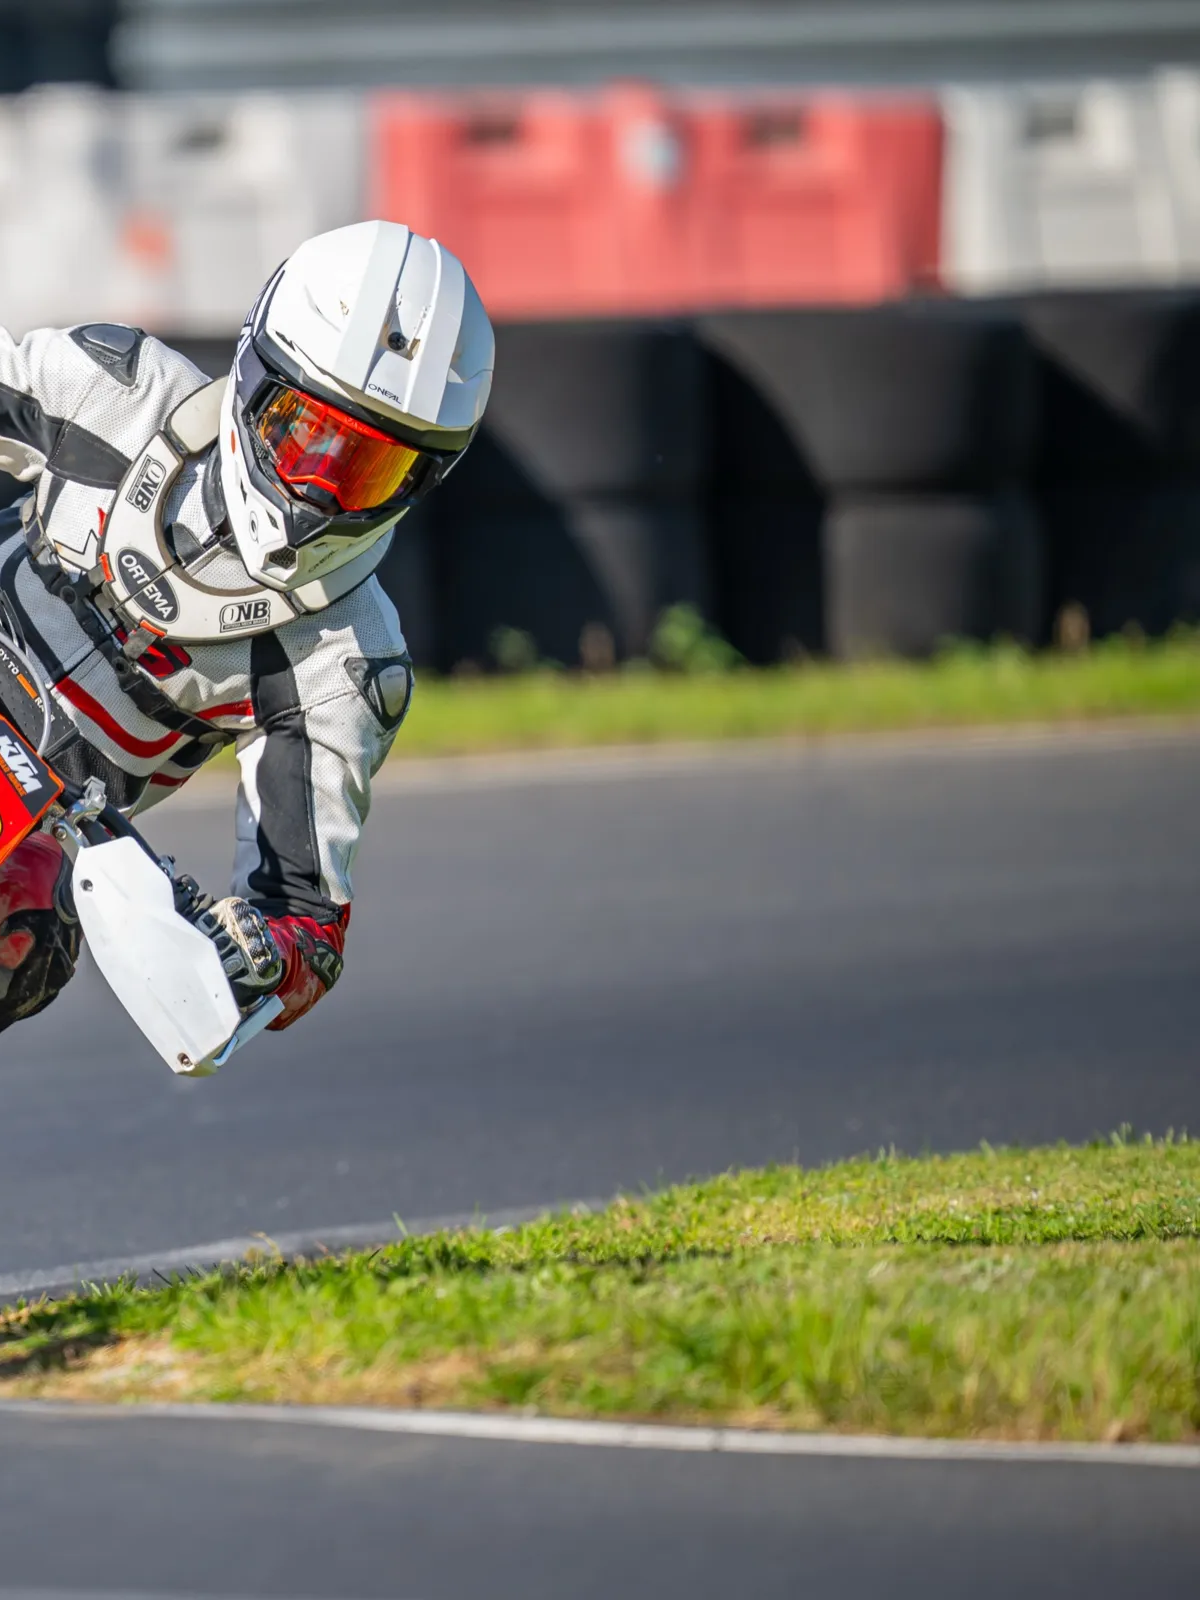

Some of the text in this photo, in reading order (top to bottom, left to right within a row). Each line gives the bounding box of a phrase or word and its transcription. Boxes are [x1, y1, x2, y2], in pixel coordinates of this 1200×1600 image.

[368, 383, 402, 405] ONEAL
[121, 554, 175, 619] ORTEMA
[7, 660, 20, 675] TO
